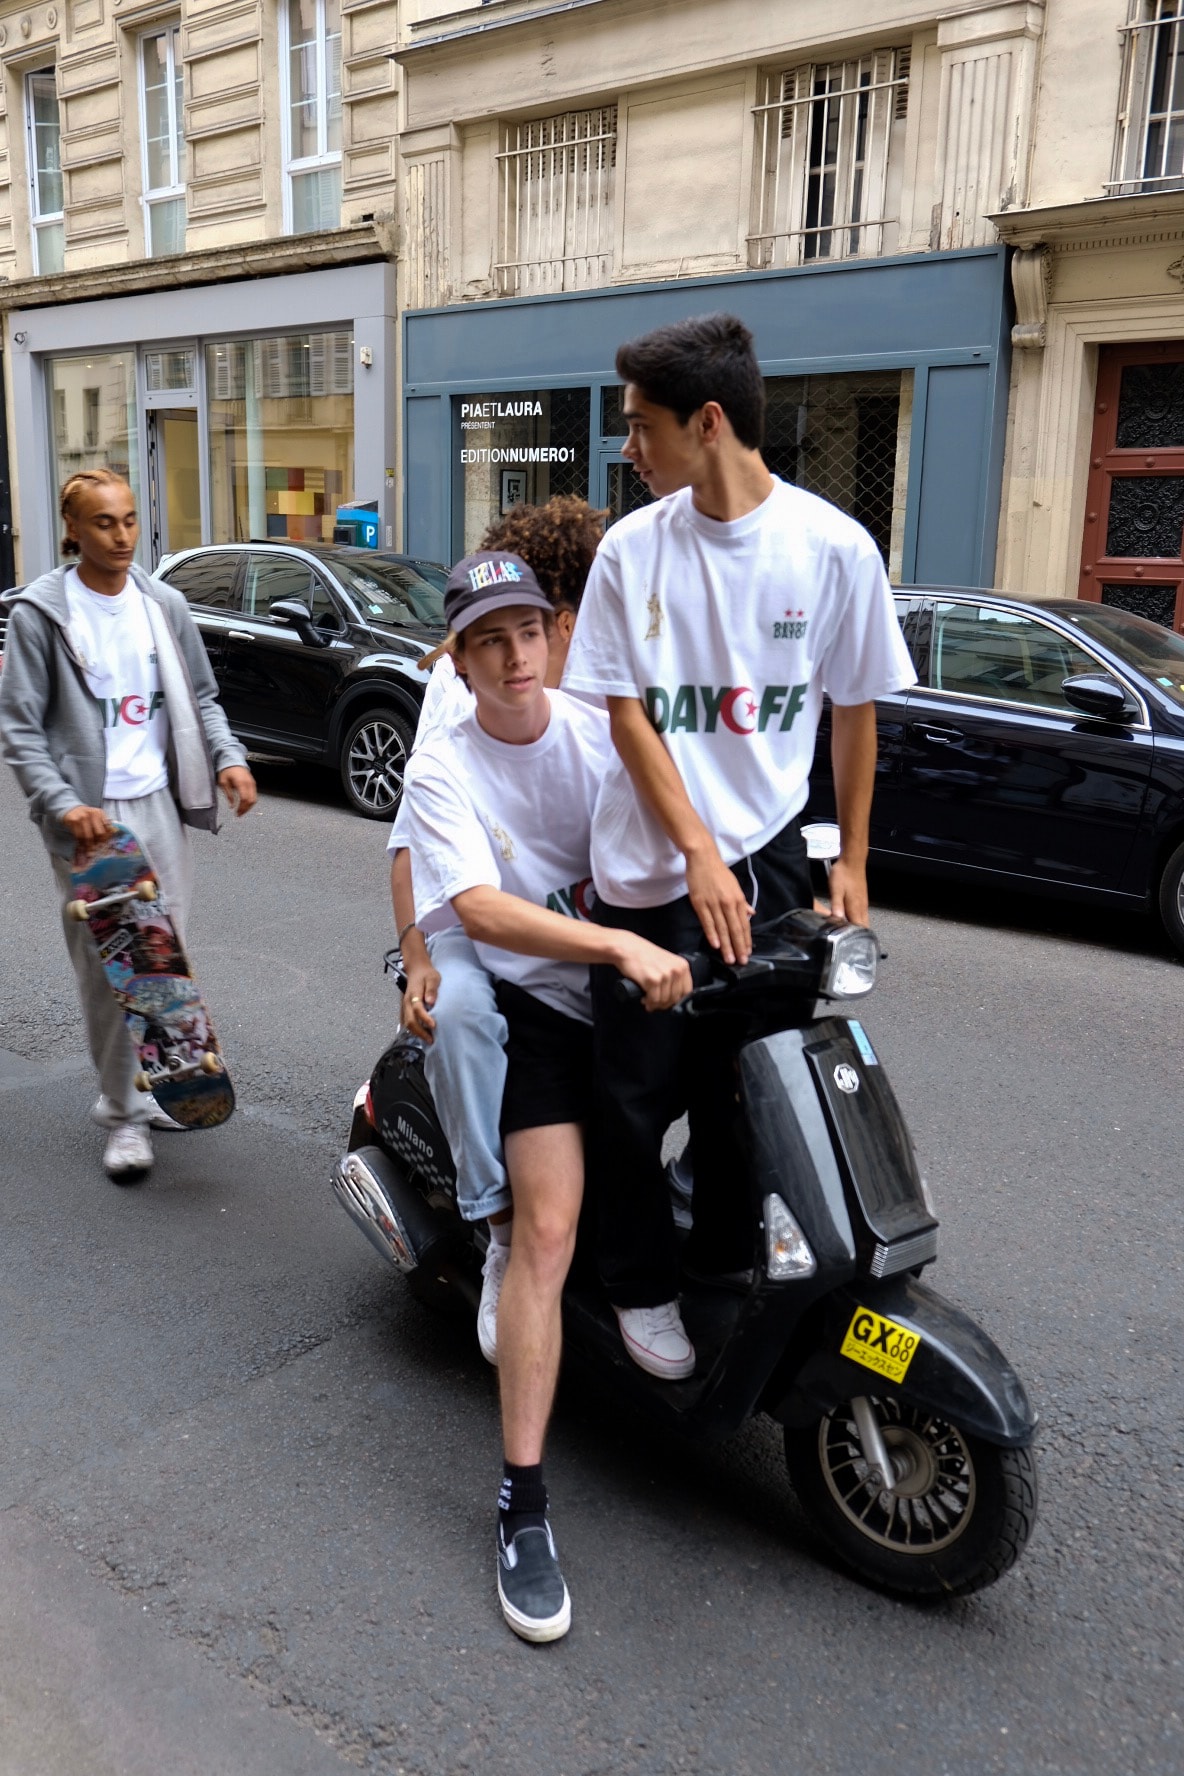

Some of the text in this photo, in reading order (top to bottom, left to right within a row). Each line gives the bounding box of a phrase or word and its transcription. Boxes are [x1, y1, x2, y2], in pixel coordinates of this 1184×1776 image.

[366, 525, 376, 543] P
[468, 561, 521, 592] HELAS
[398, 1115, 434, 1158] Milano
